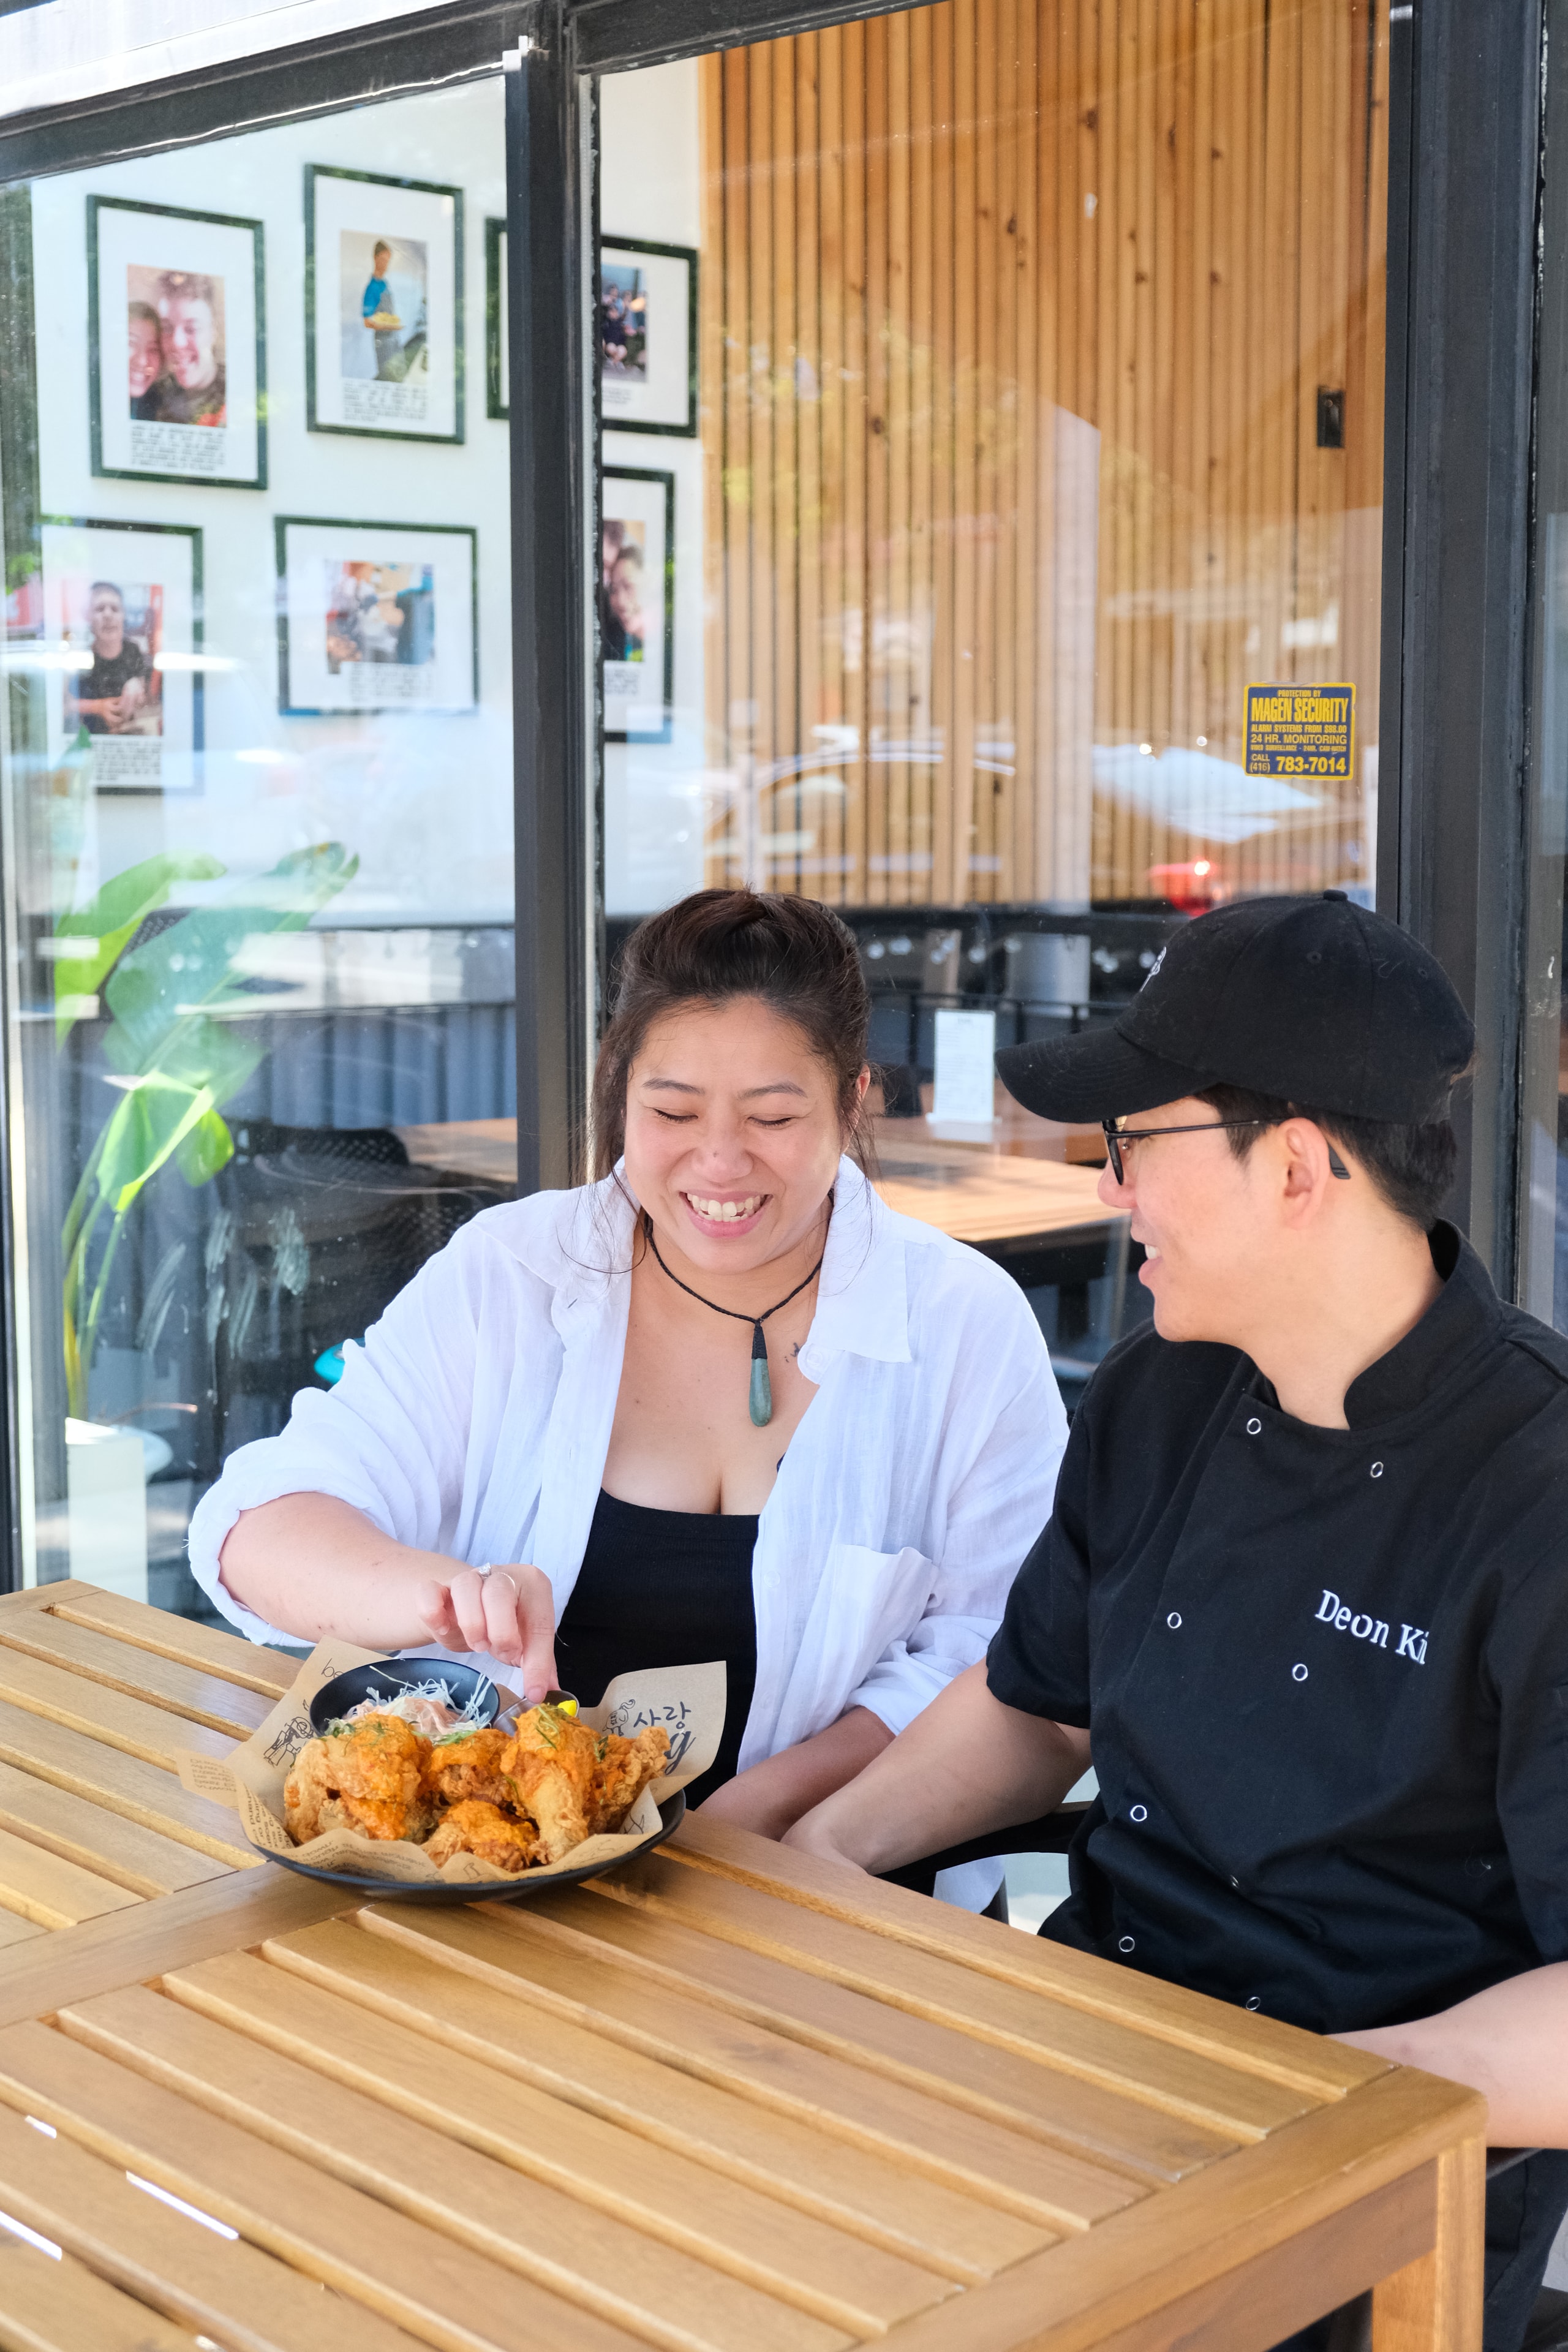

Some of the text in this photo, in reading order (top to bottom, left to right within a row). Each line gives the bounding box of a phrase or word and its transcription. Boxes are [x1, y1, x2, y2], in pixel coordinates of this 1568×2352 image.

[1251, 697, 1349, 722] MAGEN SECURITY
[1251, 734, 1347, 744] 24 HR. MONITORING
[1274, 724, 1302, 733] SYSTEMS
[1250, 756, 1346, 773] (416) 783-7014
[1314, 1589, 1389, 1648] Deon
[633, 1701, 692, 1729] 사랑
